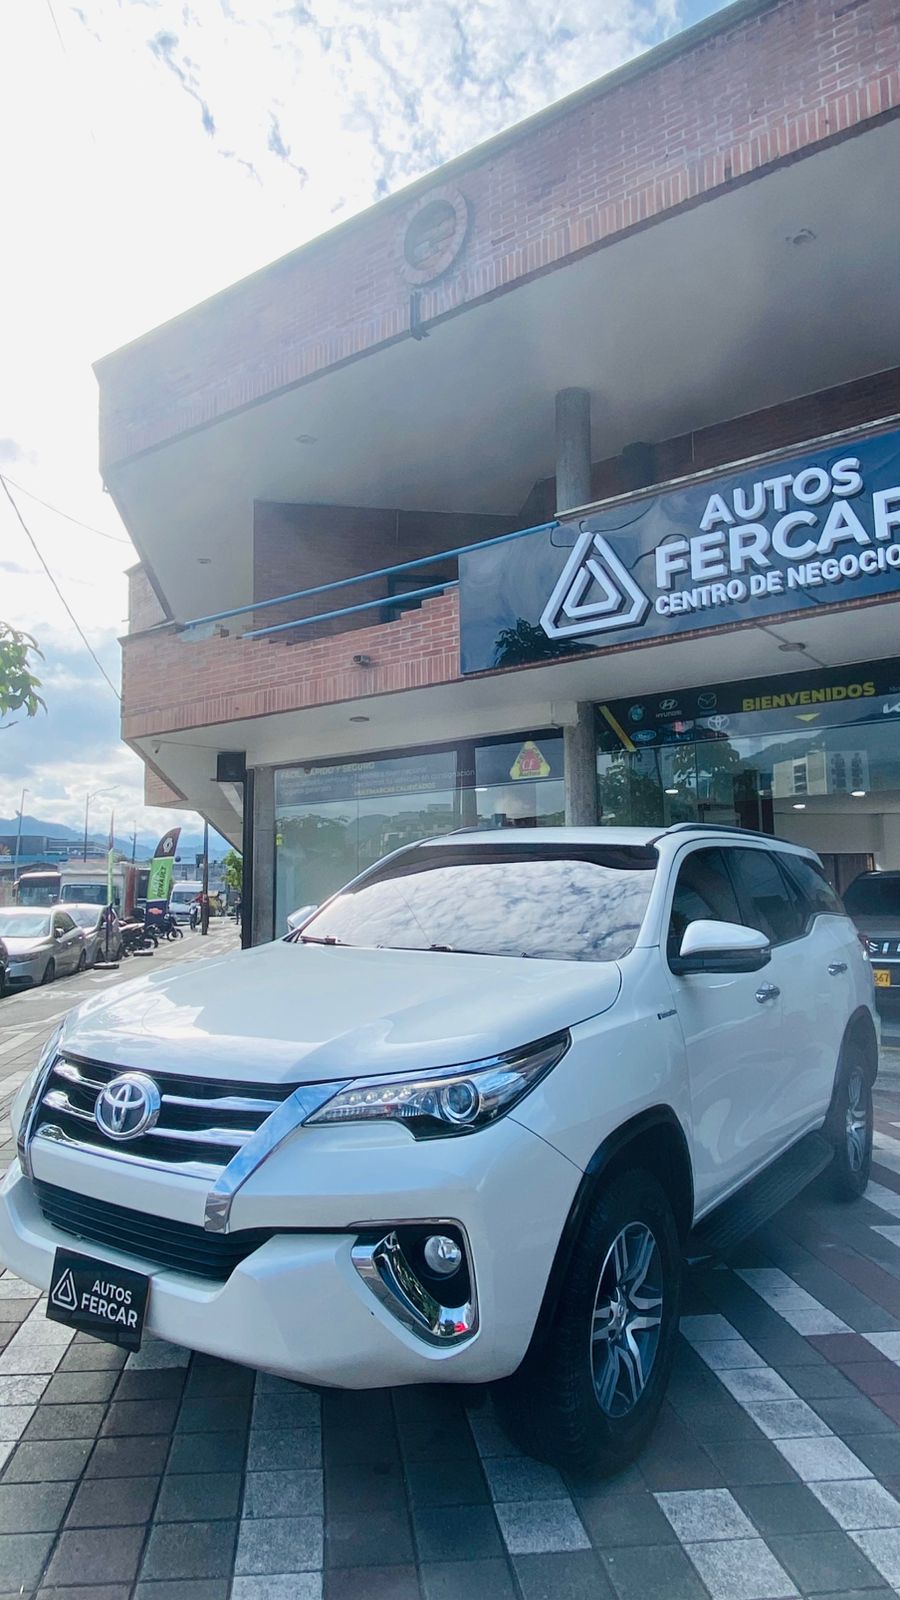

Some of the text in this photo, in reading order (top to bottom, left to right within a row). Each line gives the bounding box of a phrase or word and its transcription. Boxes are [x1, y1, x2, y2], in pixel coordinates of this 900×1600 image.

[699, 457, 863, 531] AUTOS
[655, 578, 747, 616] CENTRO
[750, 570, 784, 598] DE
[742, 681, 876, 712] BIENVENIDOS
[655, 710, 682, 718] HYUNDAI
[342, 762, 376, 774] SEGURO
[92, 1280, 132, 1305] AUTOS
[81, 1293, 138, 1329] FERCAR
